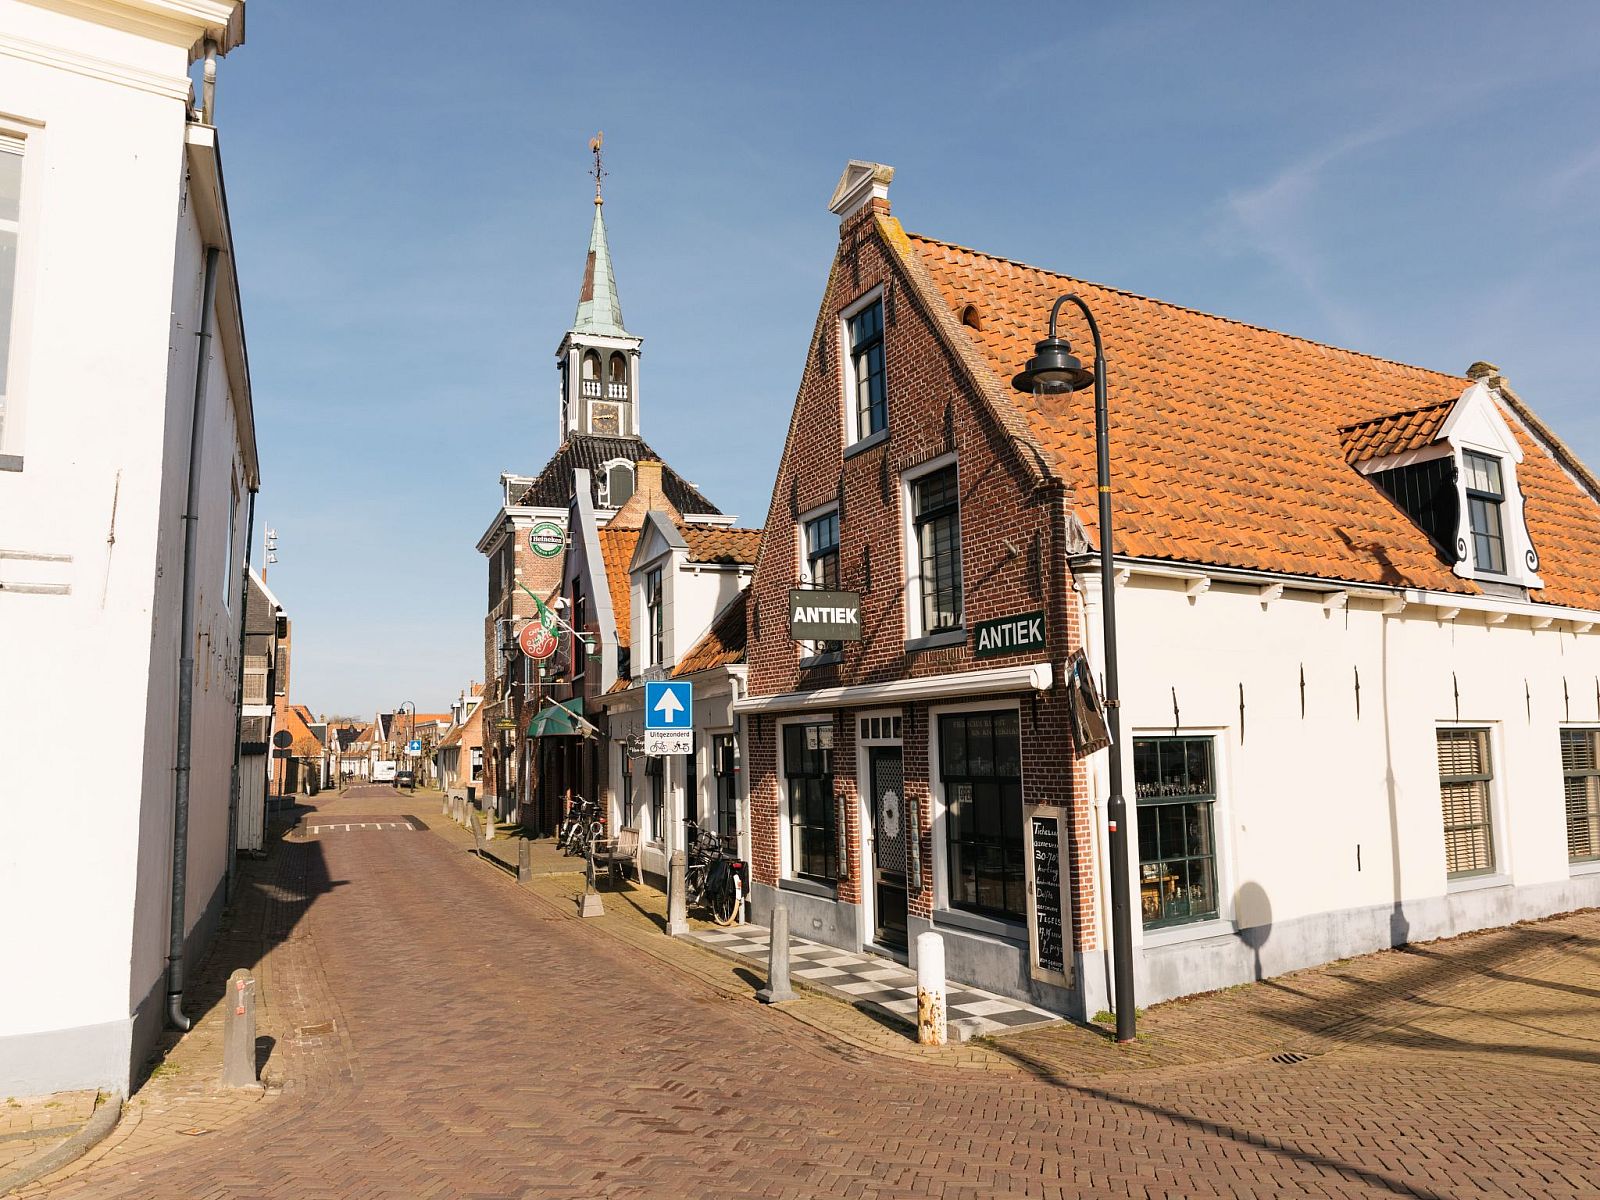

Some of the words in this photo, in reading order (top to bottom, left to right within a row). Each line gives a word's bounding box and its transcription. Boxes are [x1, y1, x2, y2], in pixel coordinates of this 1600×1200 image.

[533, 536, 562, 544] Heineken
[793, 606, 858, 624] ANTIEK
[978, 618, 1043, 650] ANTIEK
[650, 731, 690, 739] Uitgezonderd
